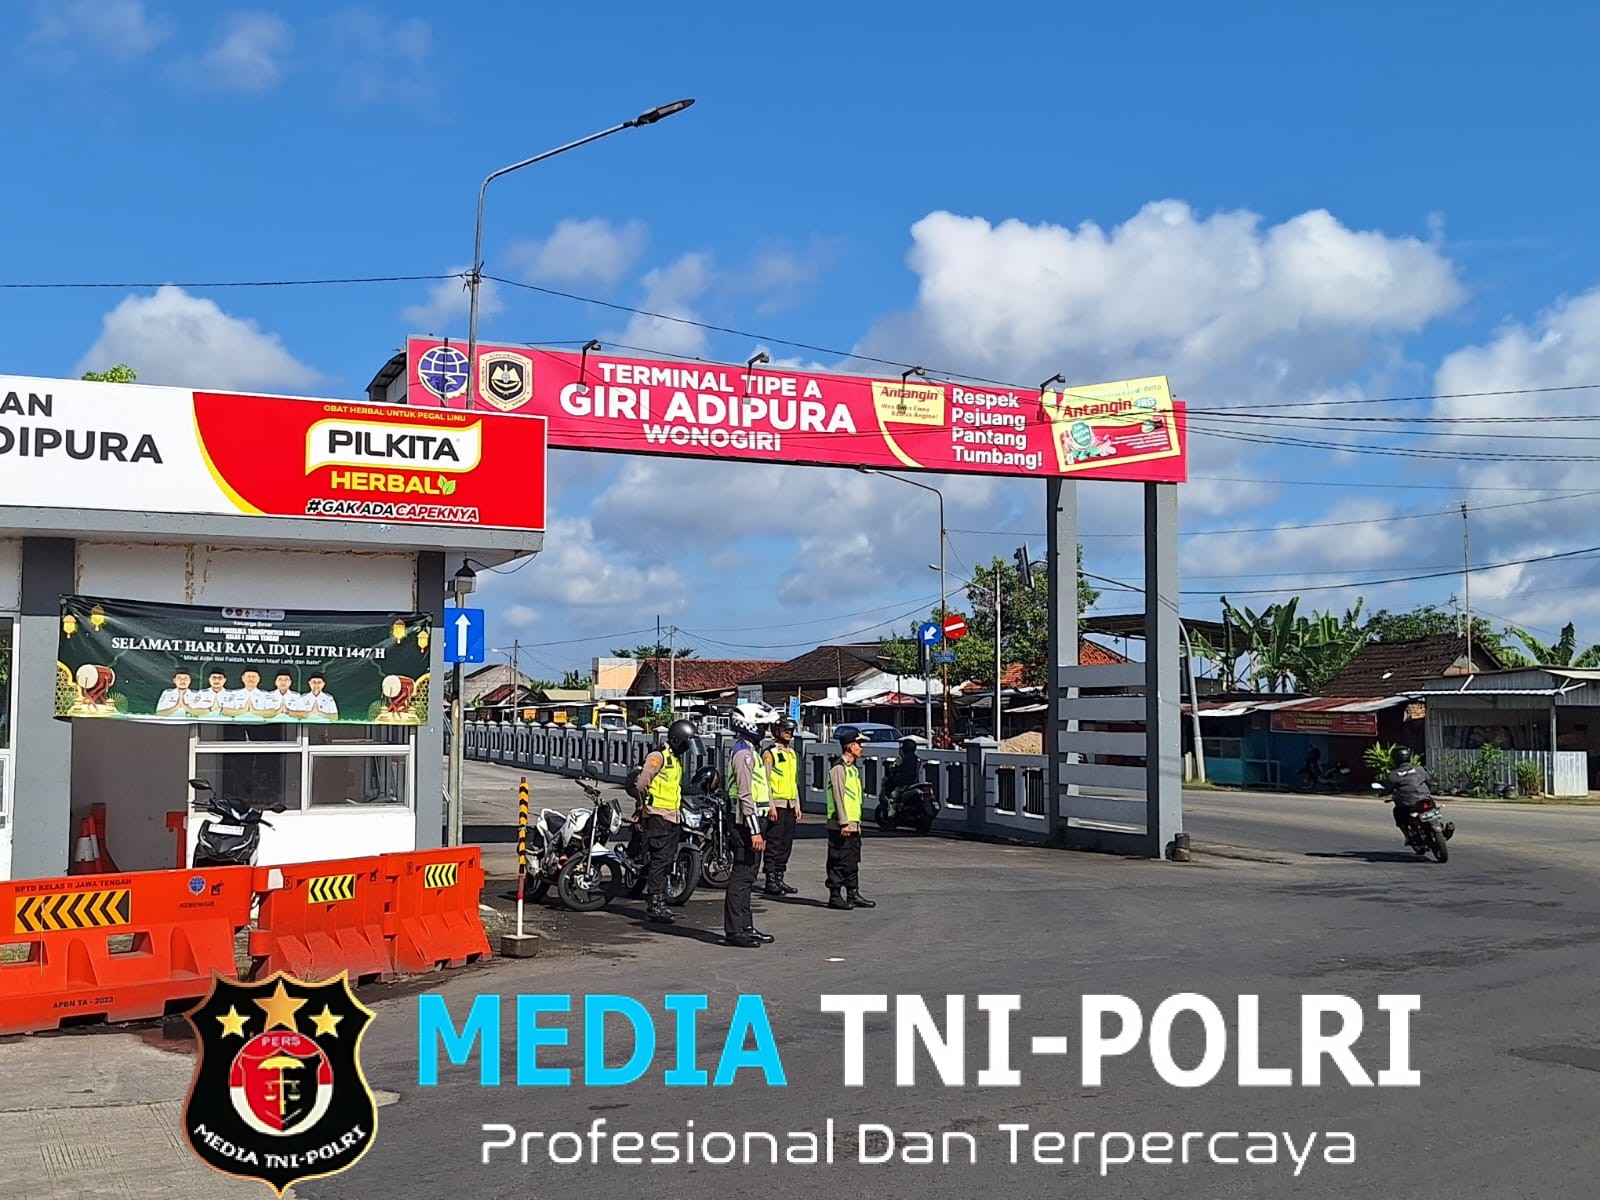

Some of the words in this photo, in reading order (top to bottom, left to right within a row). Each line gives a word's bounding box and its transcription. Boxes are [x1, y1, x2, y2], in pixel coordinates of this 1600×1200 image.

[598, 362, 734, 393] TERMINAL
[741, 374, 797, 397] TIPE
[803, 379, 822, 399] A
[0, 391, 53, 417] AN
[881, 386, 938, 402] Antangin
[952, 387, 1020, 410] Respek
[323, 404, 351, 412] OBAT
[350, 406, 385, 417] HERBAL
[386, 410, 416, 419] UNTUK
[417, 412, 445, 421] PEGAL
[559, 383, 651, 421] GIRI
[664, 391, 857, 435] ADIPURA
[952, 407, 1027, 431] Pejuang
[1063, 398, 1133, 418] Antangin
[328, 429, 460, 462] PILKITA
[642, 424, 781, 451] WONOGIRI
[952, 426, 1027, 451] Pantang
[952, 445, 1042, 470] Tumbang!
[330, 470, 440, 495] HERBAL
[112, 637, 183, 652] SELAMAT
[185, 641, 222, 653] HARI
[225, 642, 265, 654] RAYA
[267, 644, 303, 656] IDUL
[306, 646, 344, 657] FITRI
[346, 648, 372, 658] 1447
[375, 648, 386, 659] H
[100, 879, 132, 887] TENGAH
